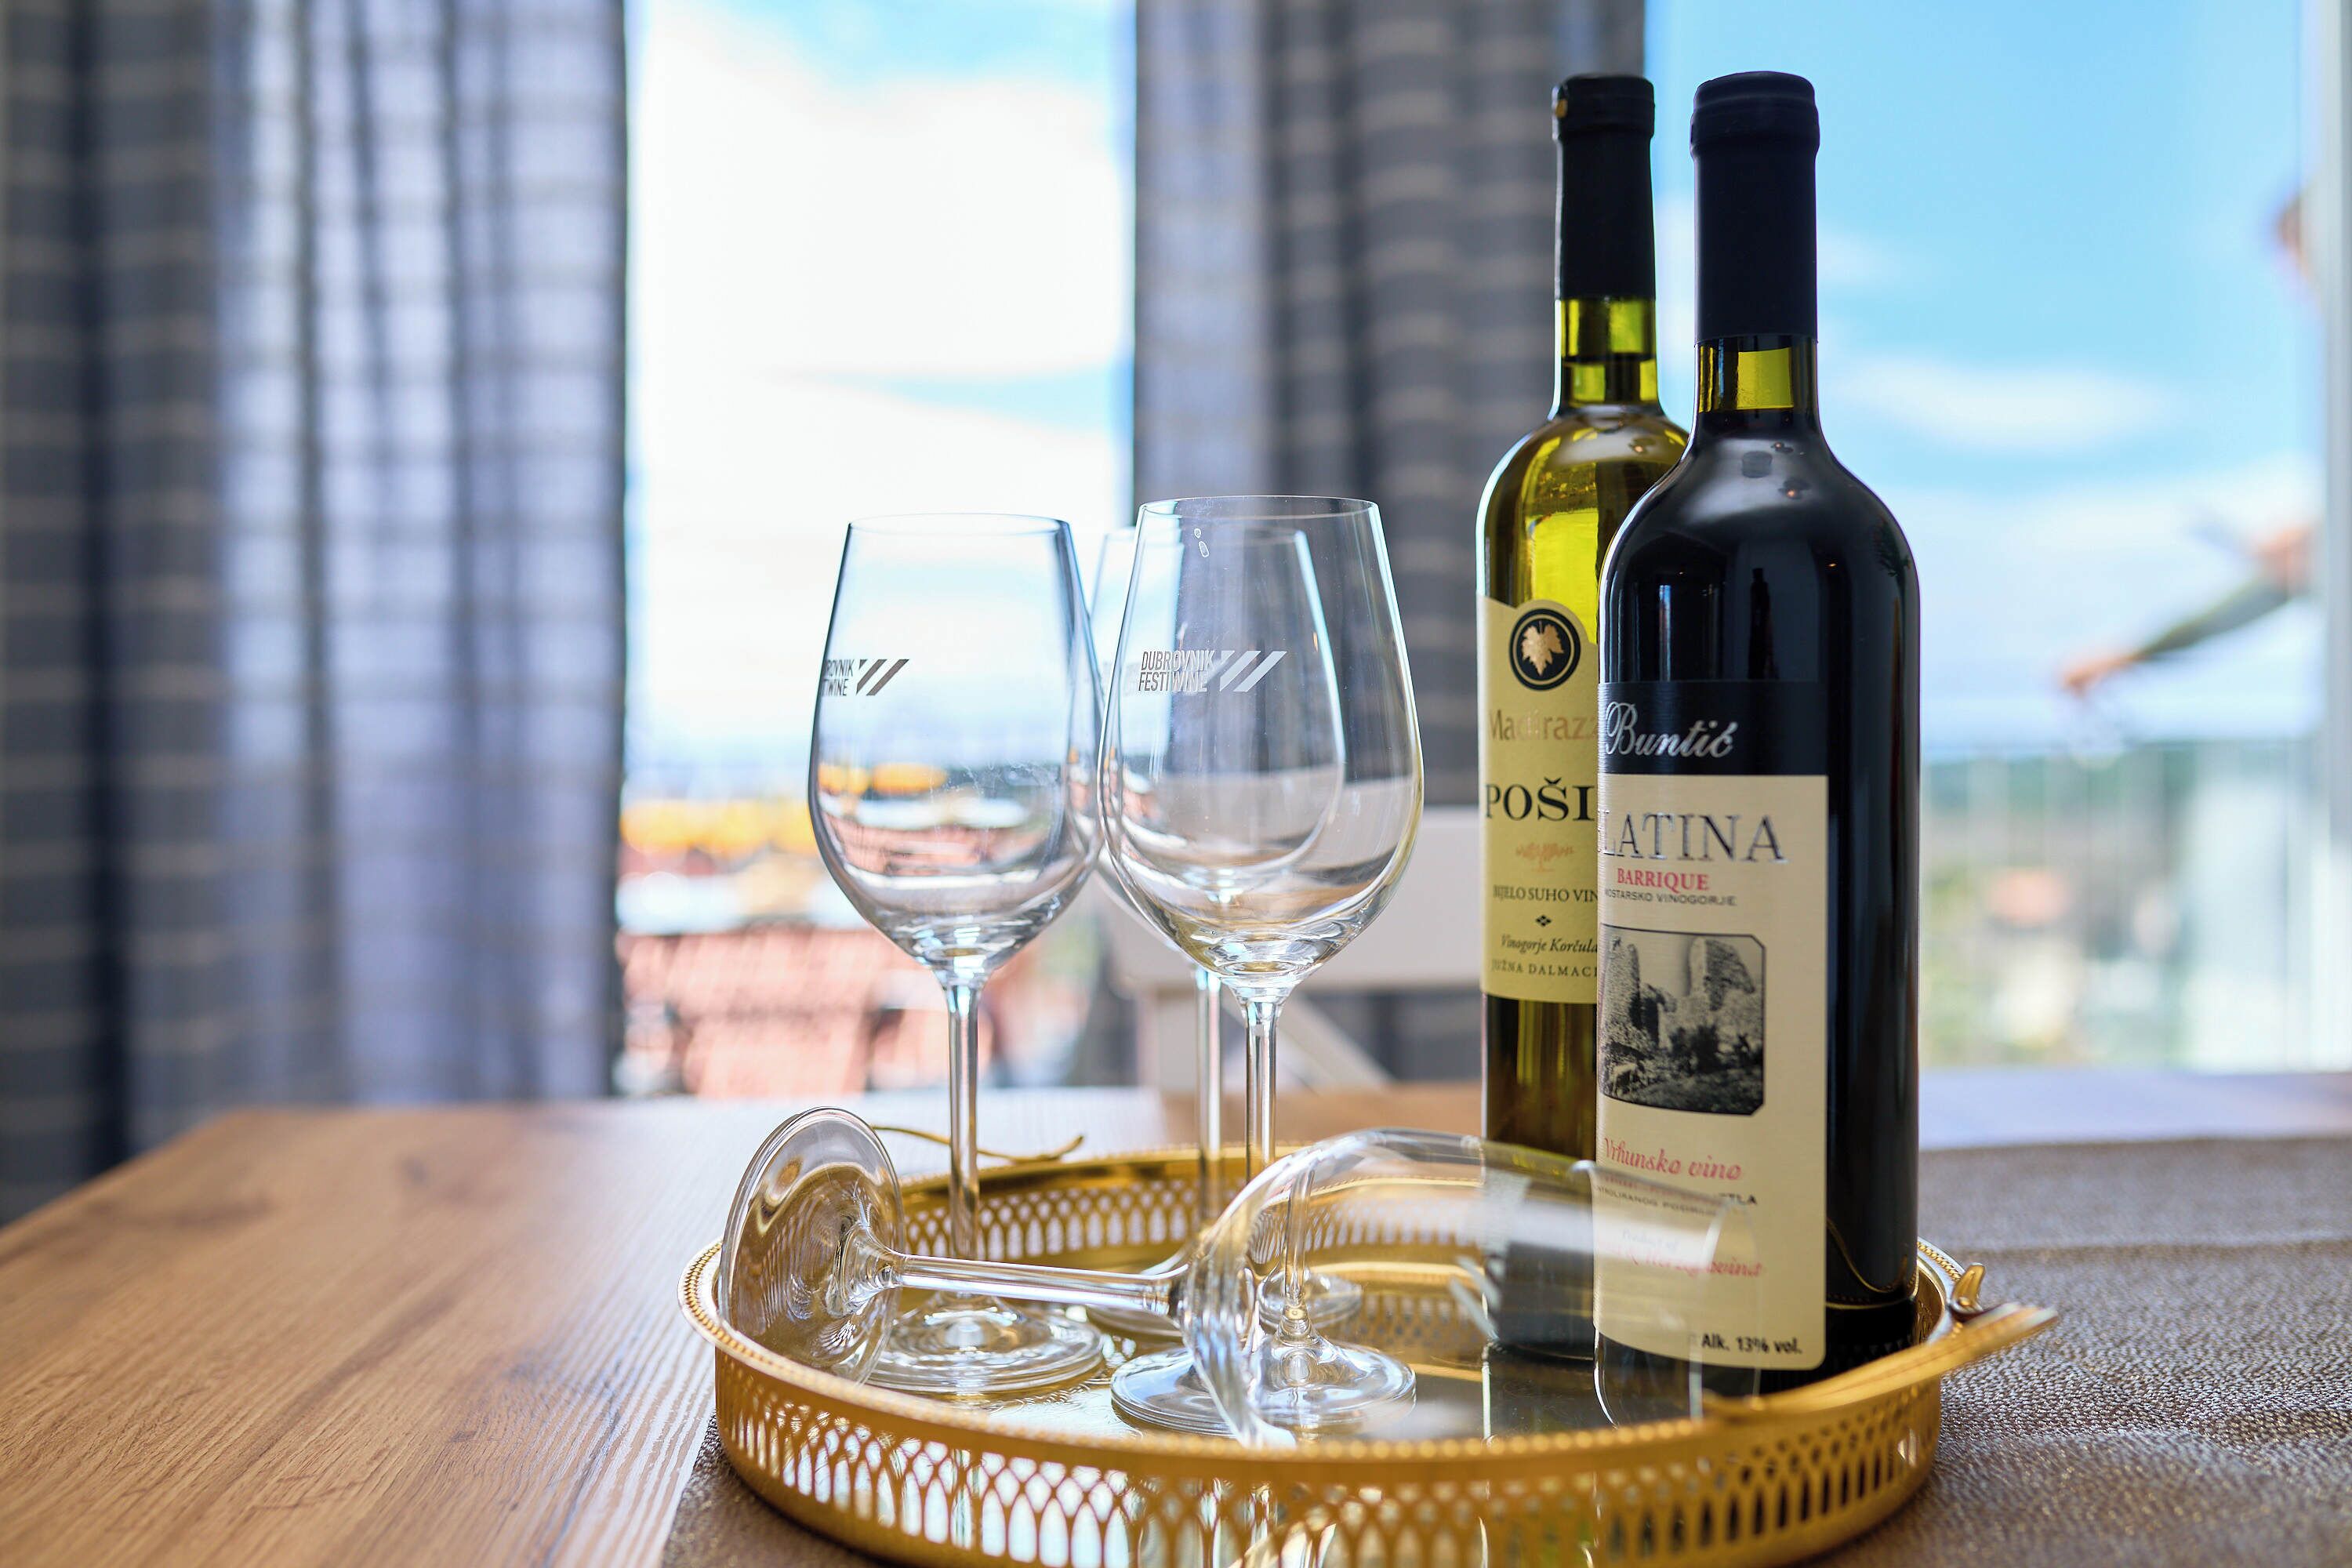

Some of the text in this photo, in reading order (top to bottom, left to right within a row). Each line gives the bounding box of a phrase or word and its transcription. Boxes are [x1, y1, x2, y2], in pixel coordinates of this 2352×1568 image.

[1141, 650, 1215, 672] DUBROVNIK
[1606, 701, 1738, 758] Buntić
[1485, 776, 1595, 822] POŠI
[1617, 867, 1711, 894] BARRIQUE
[1528, 887, 1570, 902] SUHO
[1656, 892, 1738, 906] VINOGORJE
[1501, 934, 1547, 954] Vinogorje
[1604, 1137, 1742, 1181] Vrhunsko vino
[1701, 1332, 1802, 1354] Alk. 13% vol.
